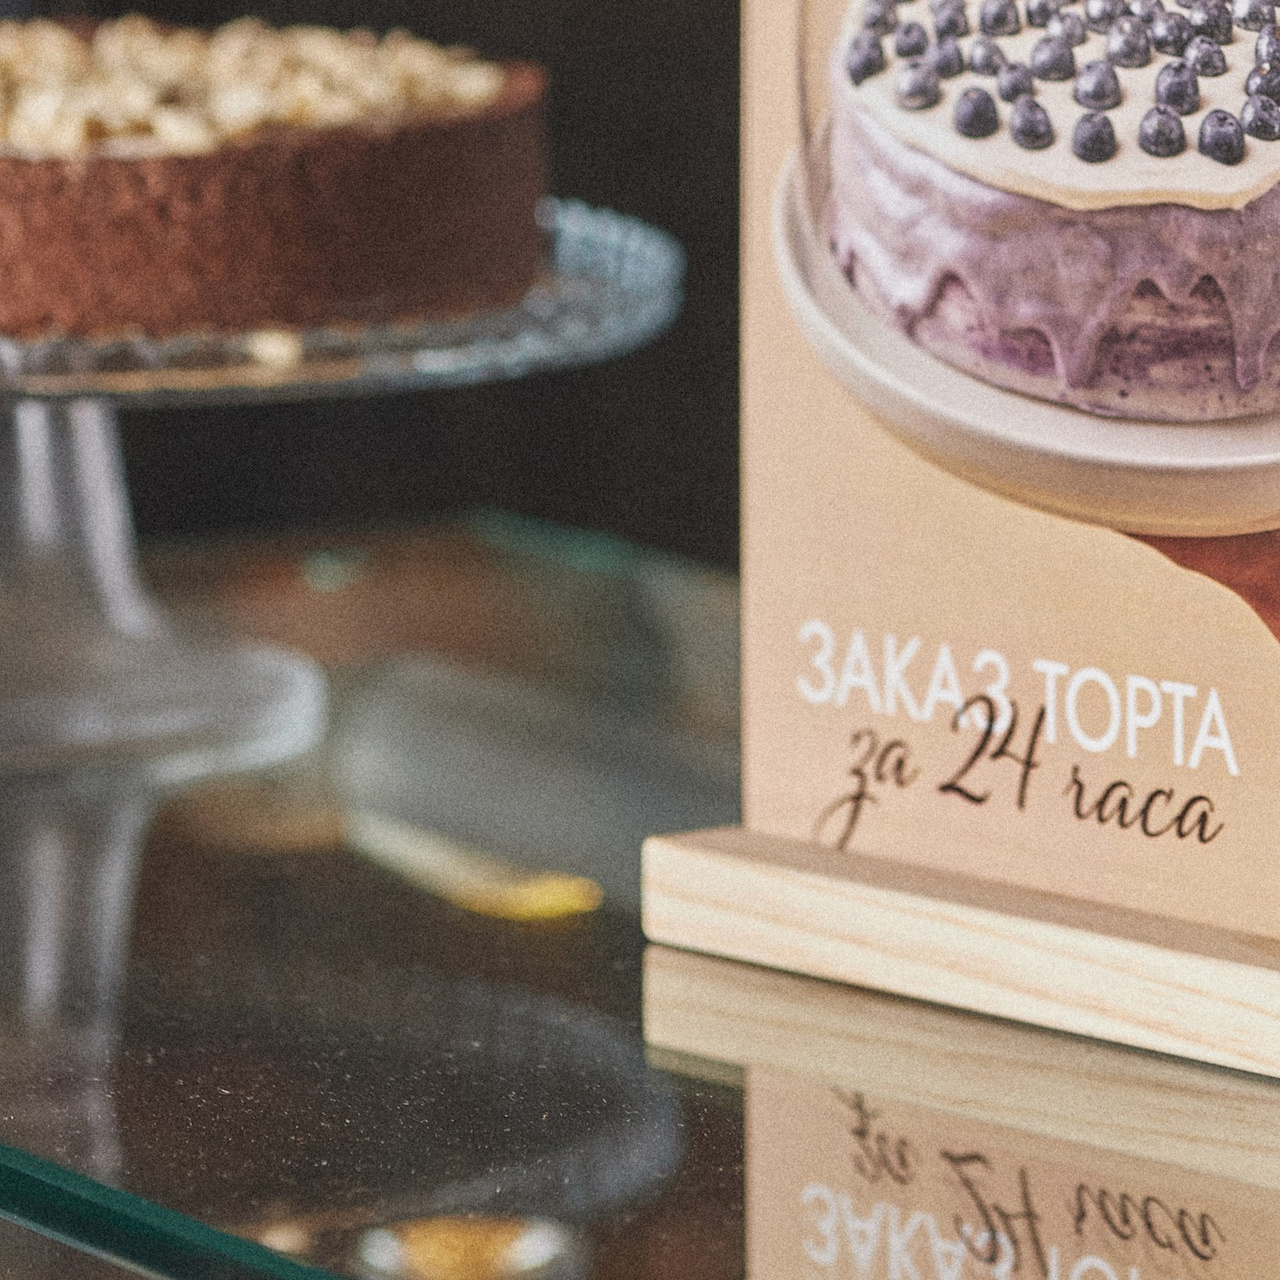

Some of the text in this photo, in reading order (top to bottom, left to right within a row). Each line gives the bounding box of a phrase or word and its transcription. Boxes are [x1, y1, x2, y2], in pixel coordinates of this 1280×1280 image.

[796, 620, 1239, 776] ЗАКАЗ ТОРТА
[813, 728, 921, 851] за
[938, 695, 1047, 810] 24
